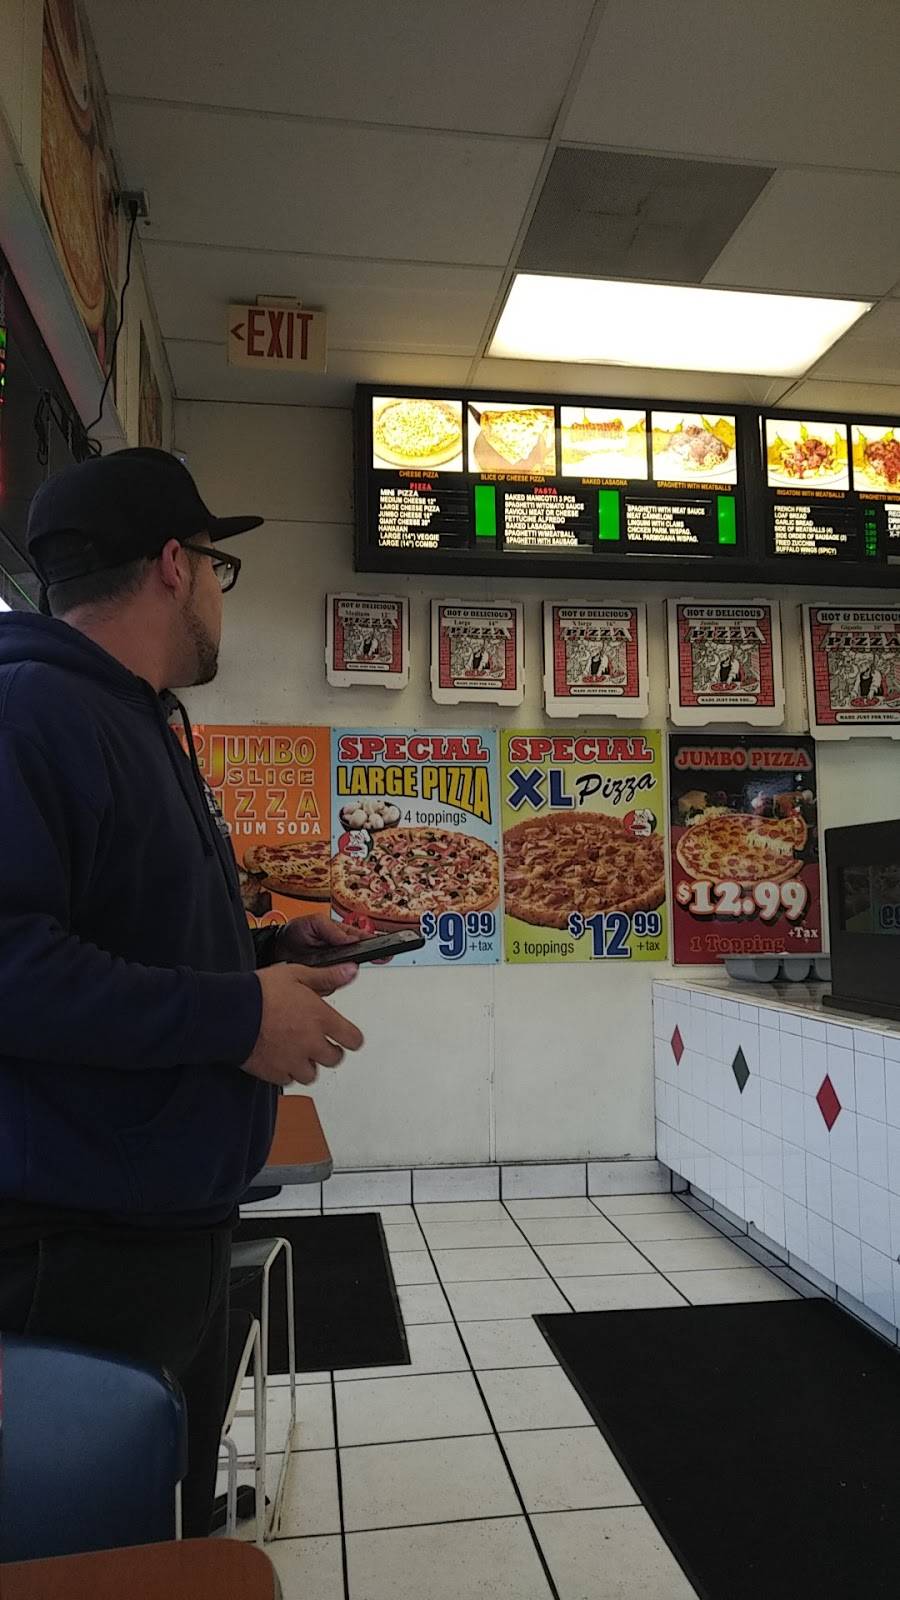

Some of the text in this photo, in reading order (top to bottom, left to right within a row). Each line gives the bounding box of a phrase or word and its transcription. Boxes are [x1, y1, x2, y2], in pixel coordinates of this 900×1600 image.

[247, 309, 314, 360] EXIT
[397, 489, 419, 497] PIZZA
[410, 482, 432, 491] PIZZA
[378, 510, 399, 518] JUMBO
[379, 539, 399, 547] LARGE
[415, 540, 438, 548] COMBO
[380, 532, 401, 540] LARGE
[416, 533, 440, 541] VEGGIE
[716, 609, 761, 617] DELICIOUS
[450, 627, 508, 637] PIZZA
[565, 628, 630, 638] PIZZA
[690, 629, 762, 640] PIZZA
[825, 636, 900, 648] PIZZA
[338, 736, 490, 762] SPECIAL
[510, 737, 653, 762] SPECIAL
[676, 750, 810, 768] JUMBO PIZZA
[227, 769, 314, 786] SLICE
[337, 766, 492, 824] LARGE PIZZA
[508, 767, 656, 809] XL Pizza
[404, 811, 467, 826] 4 toppings
[276, 822, 321, 835] SODA
[676, 880, 807, 920] $12.99
[513, 940, 574, 956] 3 toppings
[690, 935, 785, 952] 1 Topping
